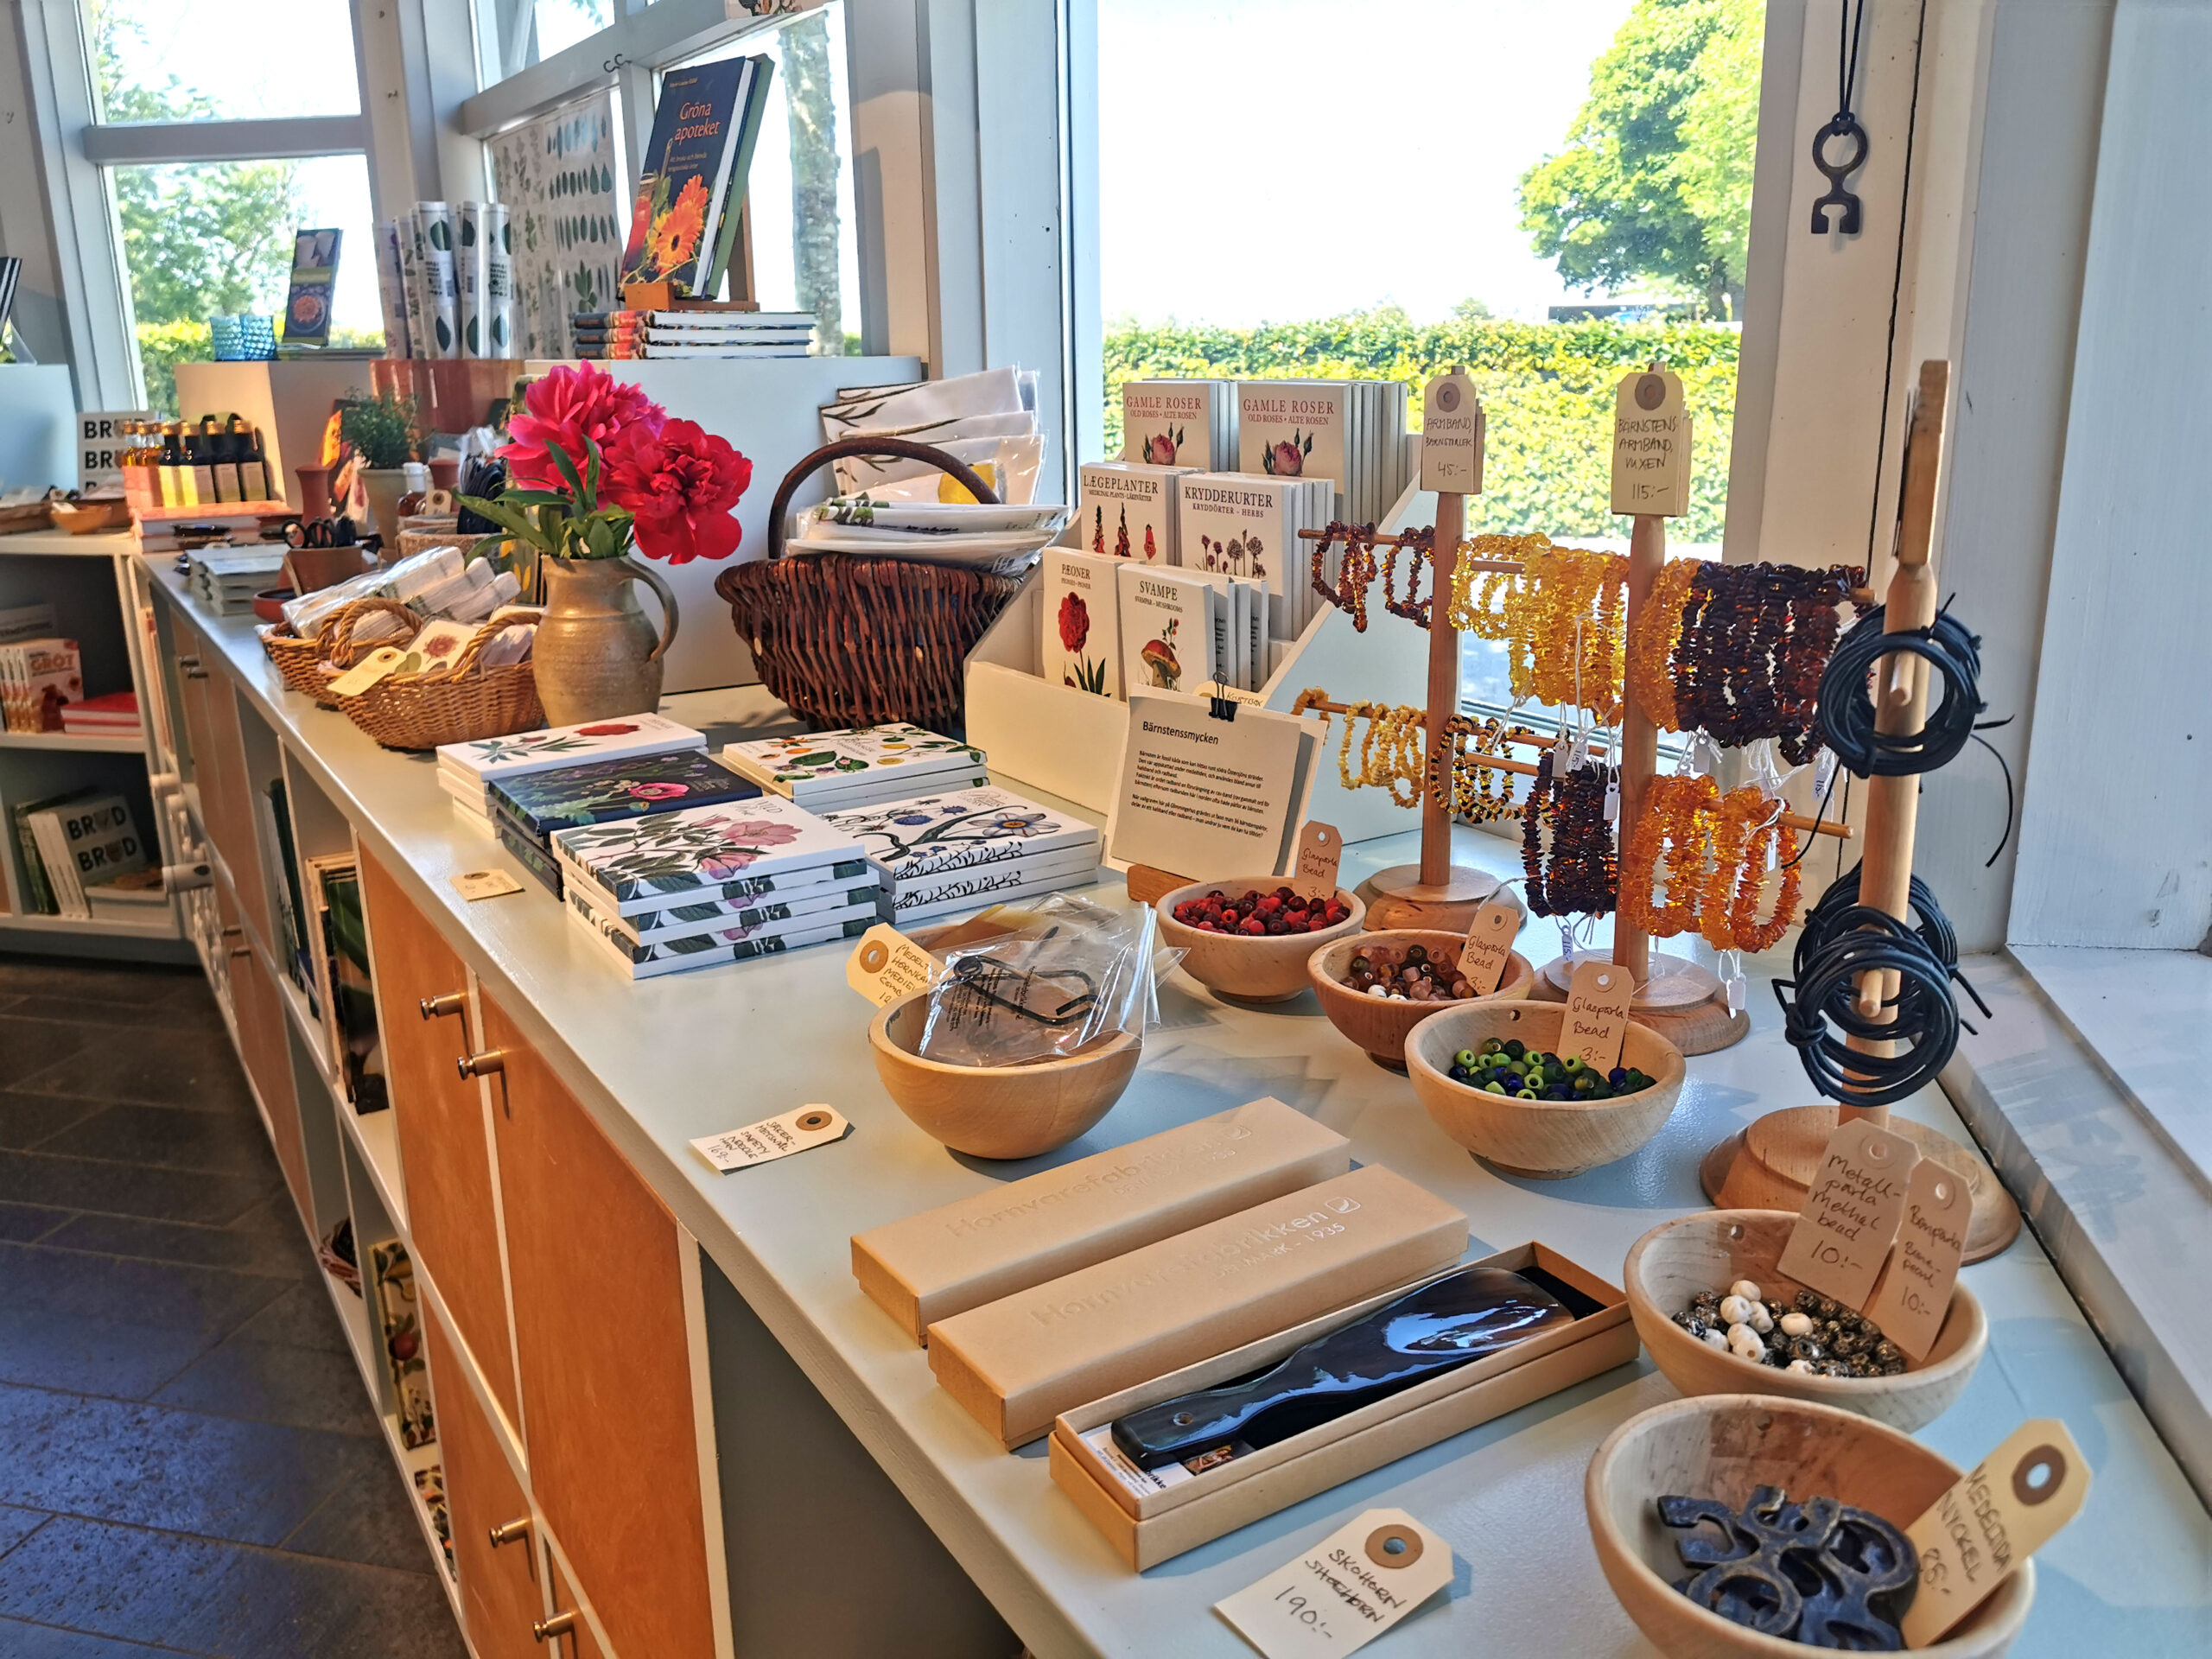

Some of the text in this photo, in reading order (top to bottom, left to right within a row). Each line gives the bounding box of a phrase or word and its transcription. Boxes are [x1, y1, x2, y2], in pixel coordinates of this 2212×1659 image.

[680, 101, 712, 120] Gröna
[674, 118, 721, 145] apoteket
[1126, 396, 1202, 410] GAMLE ROSER
[1243, 398, 1335, 415] GAMLE ROSER
[1141, 410, 1160, 418] ROSES
[1162, 410, 1177, 419] ALTE
[1177, 411, 1198, 420] ROSEN
[1262, 415, 1283, 423] ROSES
[1287, 416, 1305, 424] ALTE
[1306, 416, 1329, 425] ROSEN
[1083, 475, 1159, 494] LÆGEPLANTER
[1632, 483, 1669, 499] 115:-
[1185, 486, 1273, 508] KRYDDERURTER
[1192, 502, 1264, 518] KRYDDÖRTER HERBS
[1061, 563, 1091, 580] PÆONER
[1140, 580, 1178, 601] SVAMPE
[1142, 721, 1219, 745] Bärnstenssmycken
[1302, 863, 1325, 878] Bead
[1308, 886, 1325, 898] 3:-
[1466, 951, 1494, 970] Bead
[1471, 976, 1486, 989] 3:-
[1573, 1020, 1611, 1039] Bead
[1579, 1046, 1606, 1062] 3:-
[1304, 1222, 1346, 1243] 1935
[1811, 1239, 1863, 1270] 10:-
[1901, 1287, 1931, 1316] 10:-
[1936, 1490, 1983, 1583] NYCKEL
[1328, 1548, 1408, 1609] SKOHORN
[1274, 1585, 1332, 1639] 190:-
